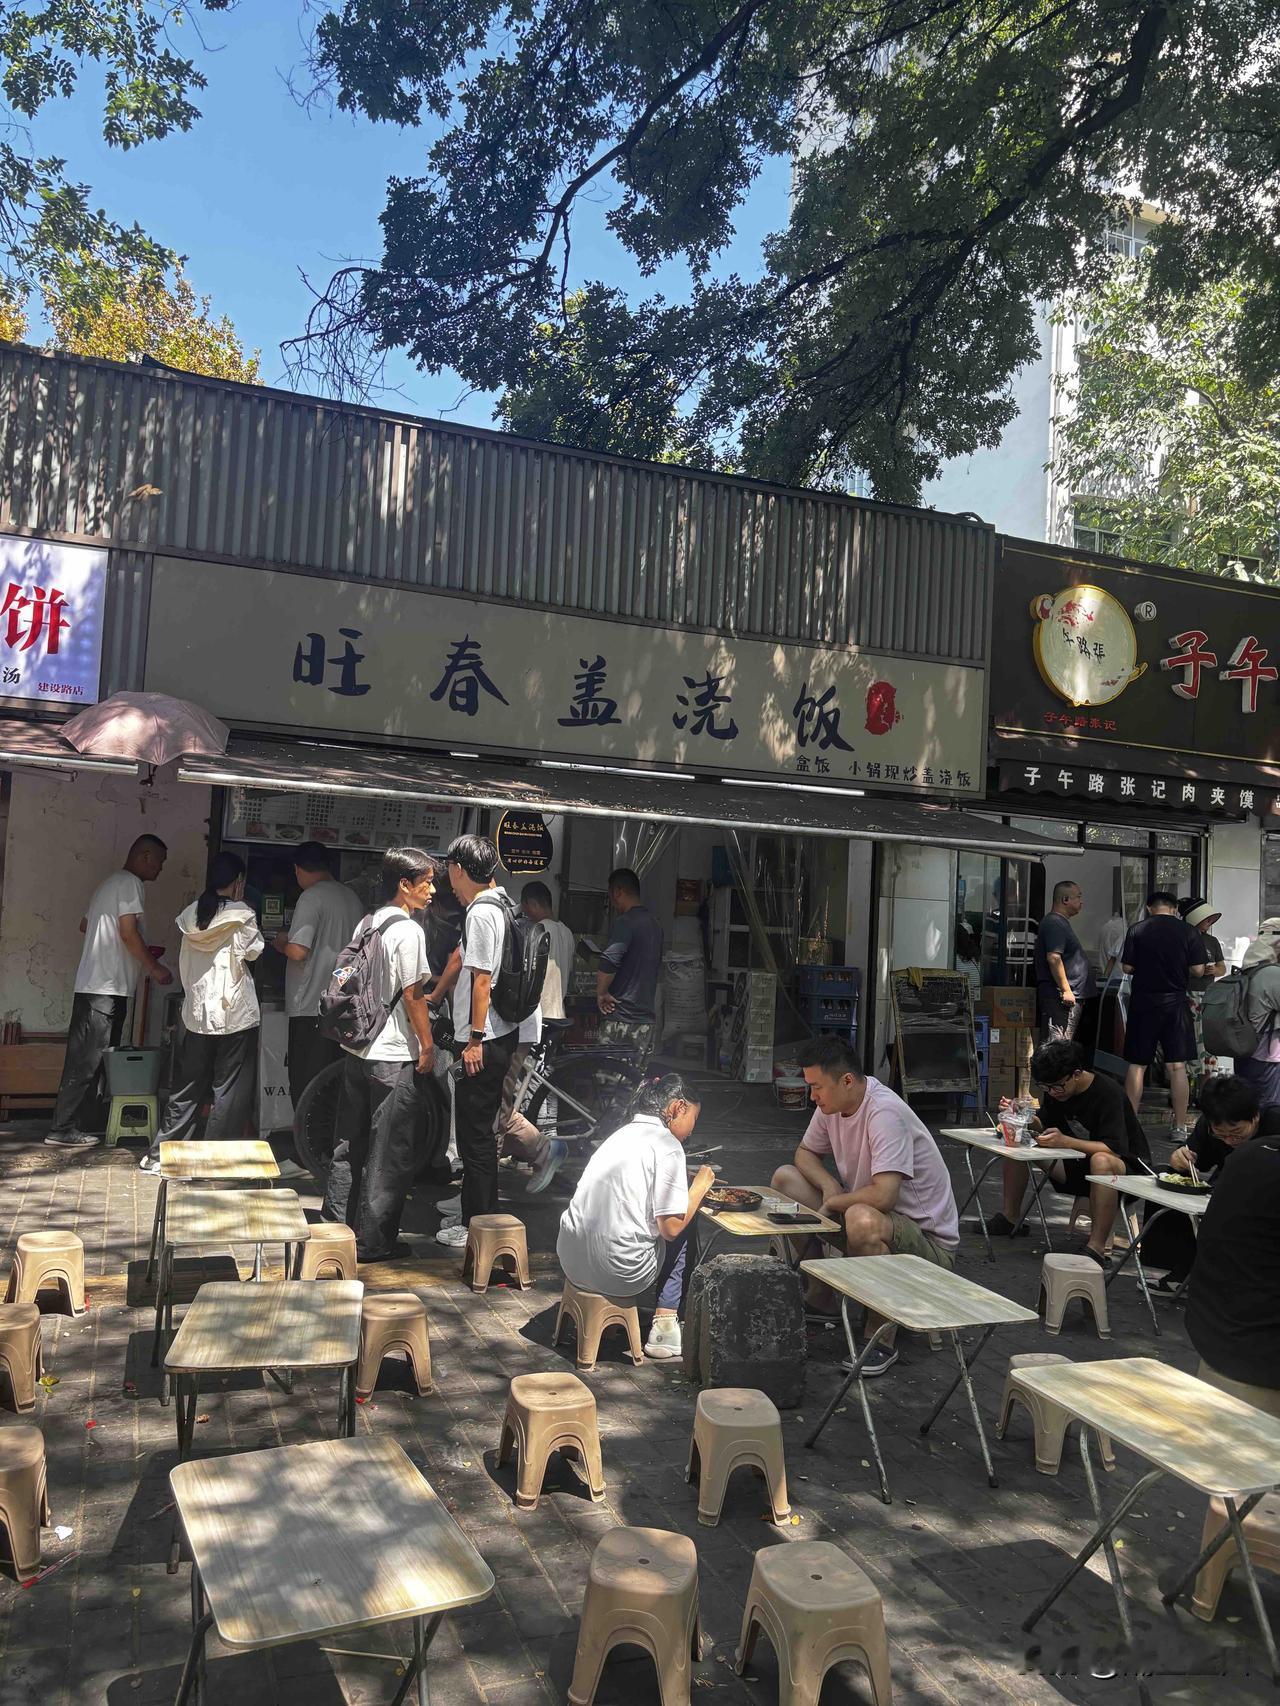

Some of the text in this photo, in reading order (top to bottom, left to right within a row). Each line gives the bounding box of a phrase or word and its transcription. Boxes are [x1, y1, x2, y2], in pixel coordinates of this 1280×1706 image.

[0, 583, 71, 655] 饼
[2, 666, 21, 684] 汤
[38, 682, 84, 696] 建设路店
[293, 628, 855, 752] 旺春盖浇饭
[1160, 630, 1278, 713] 子午
[796, 754, 972, 787] 盒饭 小锅现炒盖浇饭
[1024, 766, 1255, 809] 子午路张记肉夹馍
[264, 1086, 292, 1096] WA
